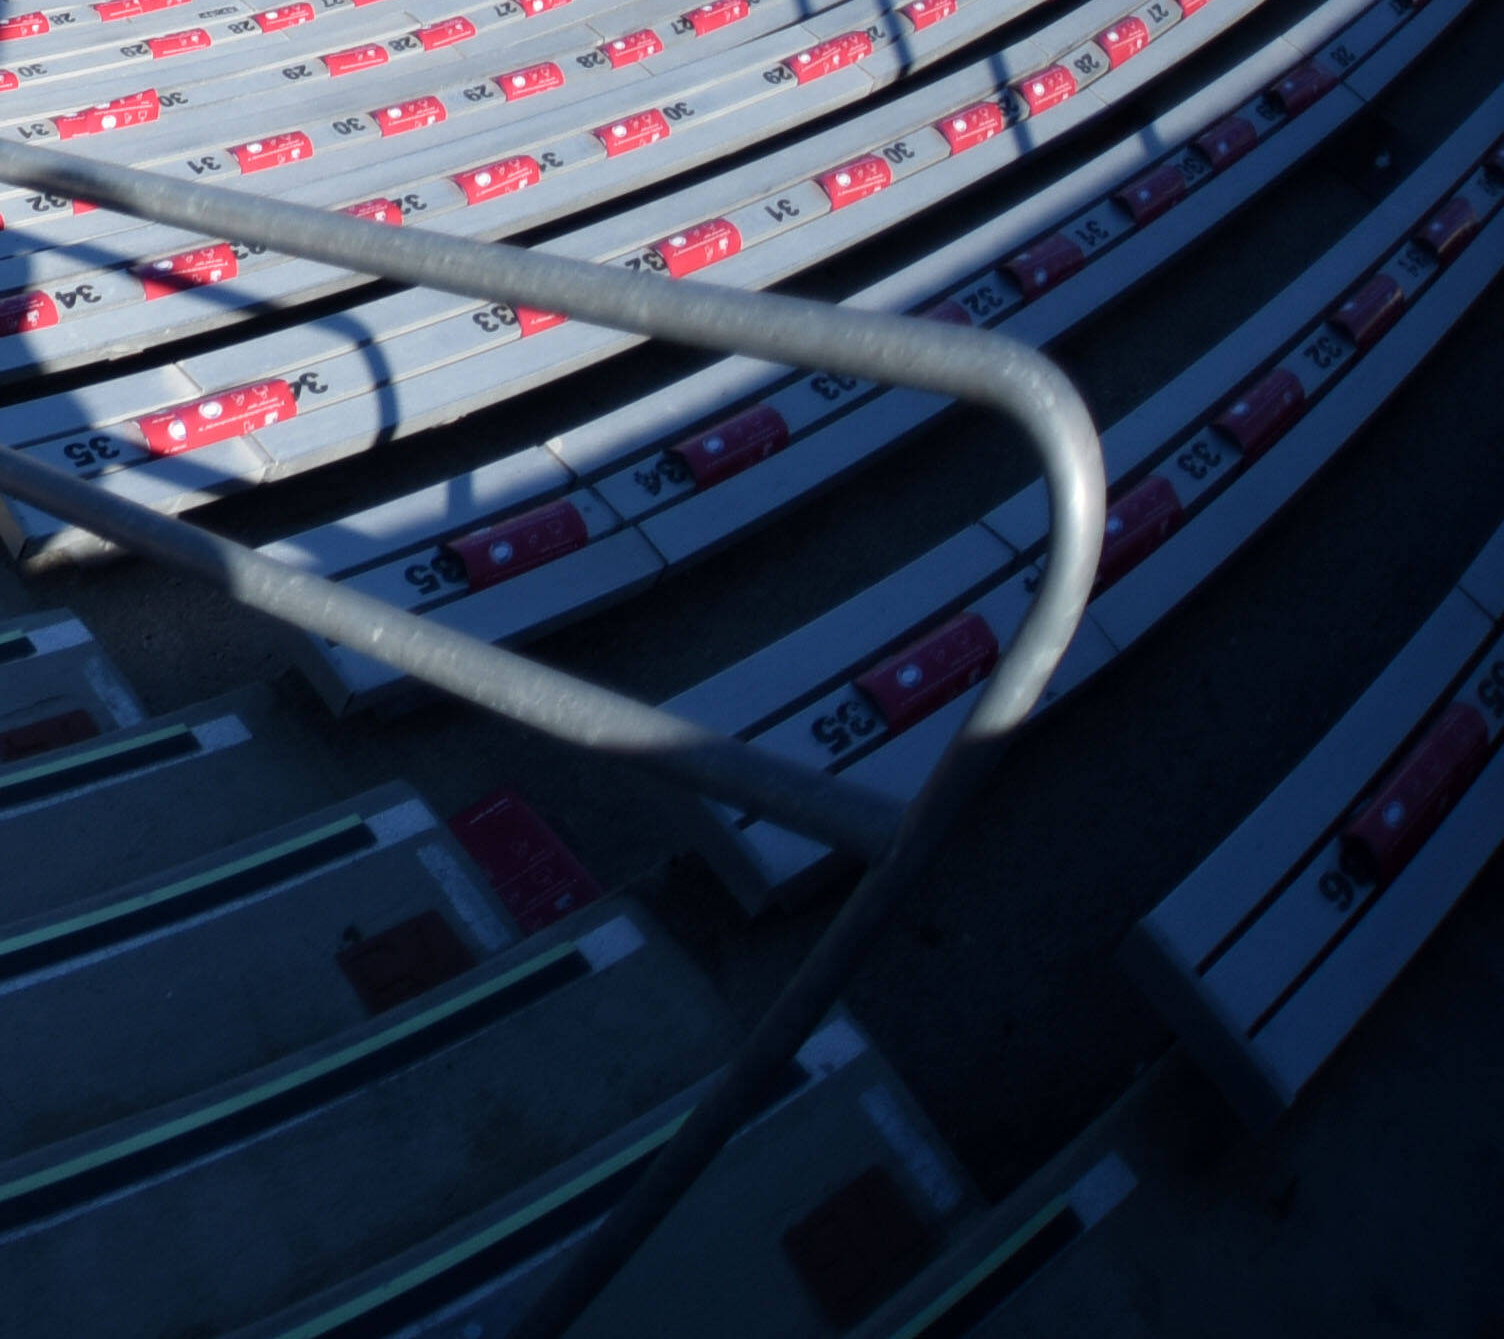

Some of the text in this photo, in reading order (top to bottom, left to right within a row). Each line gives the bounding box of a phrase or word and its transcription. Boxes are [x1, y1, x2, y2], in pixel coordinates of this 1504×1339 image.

[763, 67, 793, 85] 29
[663, 101, 695, 120] 30
[332, 118, 366, 135] 30
[883, 142, 915, 162] 30
[187, 156, 221, 174] 31
[26, 193, 67, 213] 32
[764, 200, 800, 222] 31
[54, 284, 103, 310] 34
[472, 302, 517, 333] 33
[1304, 337, 1344, 369] 32
[64, 436, 121, 467] 35
[1177, 444, 1223, 480] 33
[812, 701, 879, 754] 35
